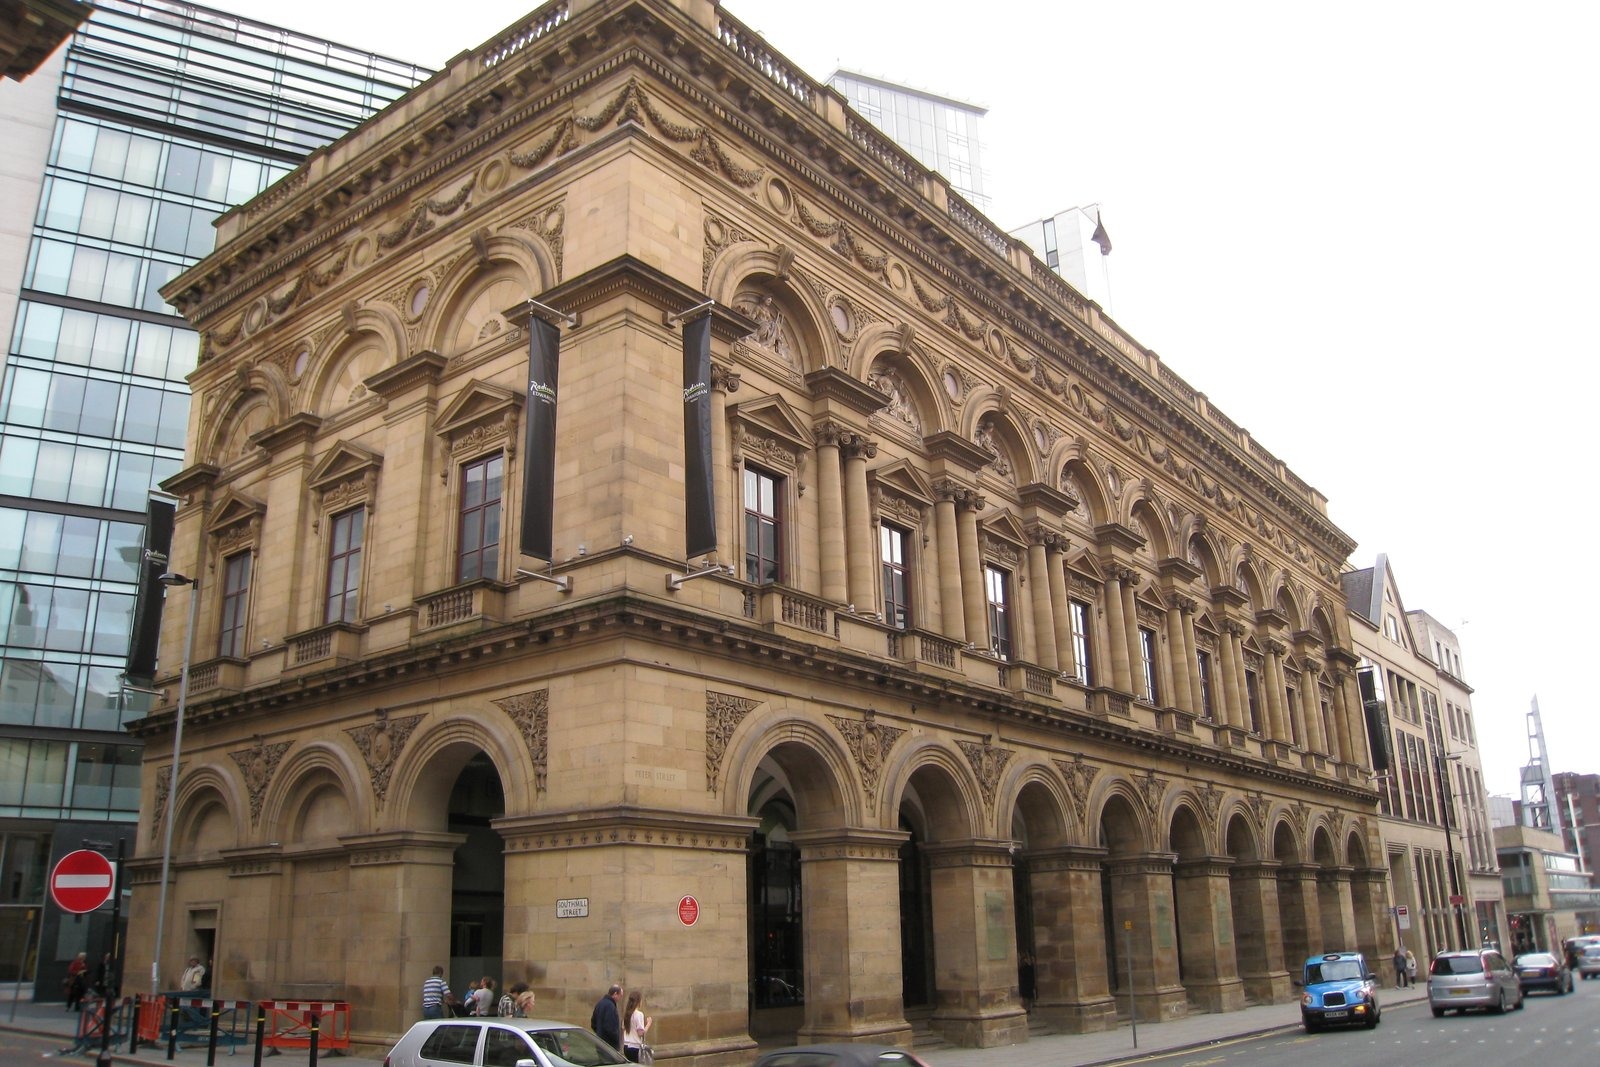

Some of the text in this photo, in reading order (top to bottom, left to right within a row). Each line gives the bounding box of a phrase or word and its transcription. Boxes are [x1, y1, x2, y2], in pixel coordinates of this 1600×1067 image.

[532, 390, 557, 405] EDWARD
[558, 900, 587, 908] SOUTHMILL
[562, 908, 582, 916] STREET
